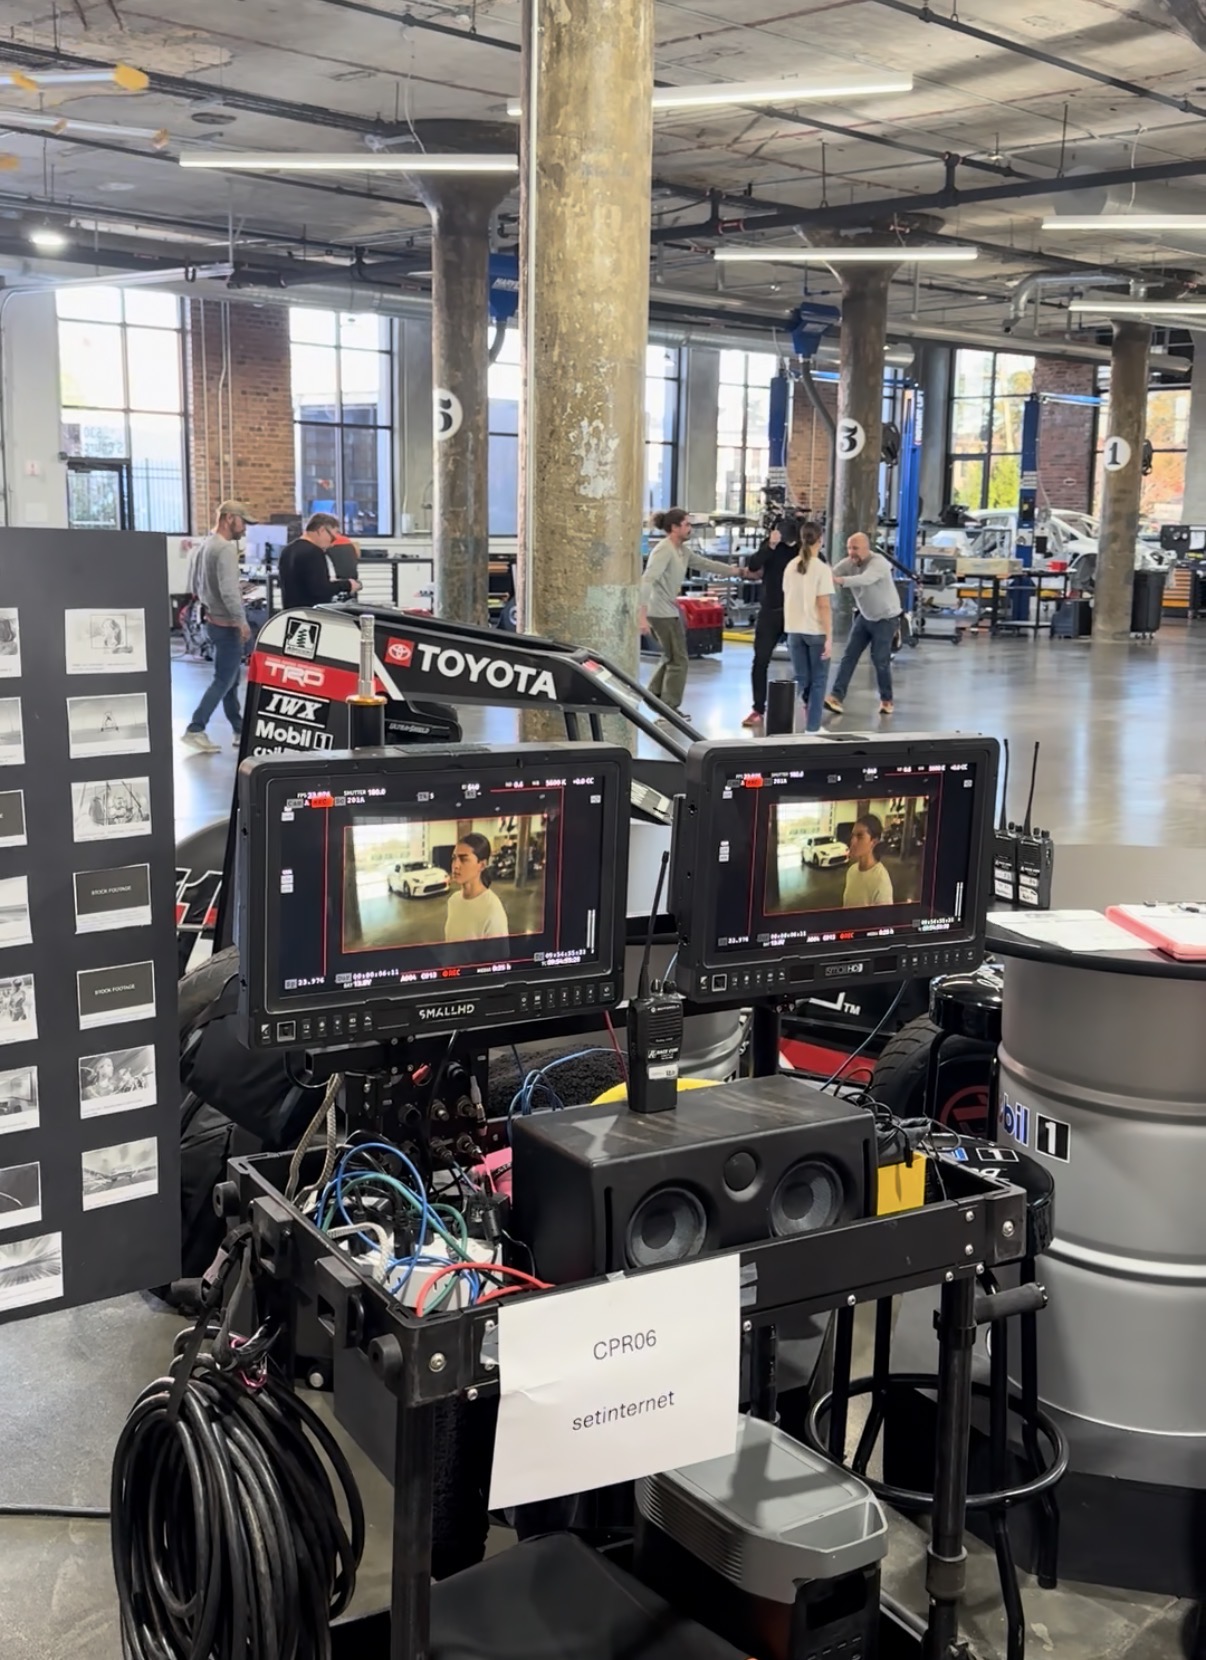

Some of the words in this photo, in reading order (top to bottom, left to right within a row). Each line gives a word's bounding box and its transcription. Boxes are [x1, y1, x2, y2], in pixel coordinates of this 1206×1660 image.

[839, 425, 859, 452] 3
[1109, 442, 1121, 466] 1
[264, 659, 325, 687] TRD
[417, 643, 557, 700] TOYOTA
[265, 693, 322, 721] IWX
[255, 719, 312, 748] Mobil
[94, 987, 112, 996] STOCK
[419, 1003, 475, 1020] SMALLHD
[843, 1002, 861, 1016] TM
[593, 1329, 657, 1361] CPR06
[572, 1391, 675, 1431] setinternet
